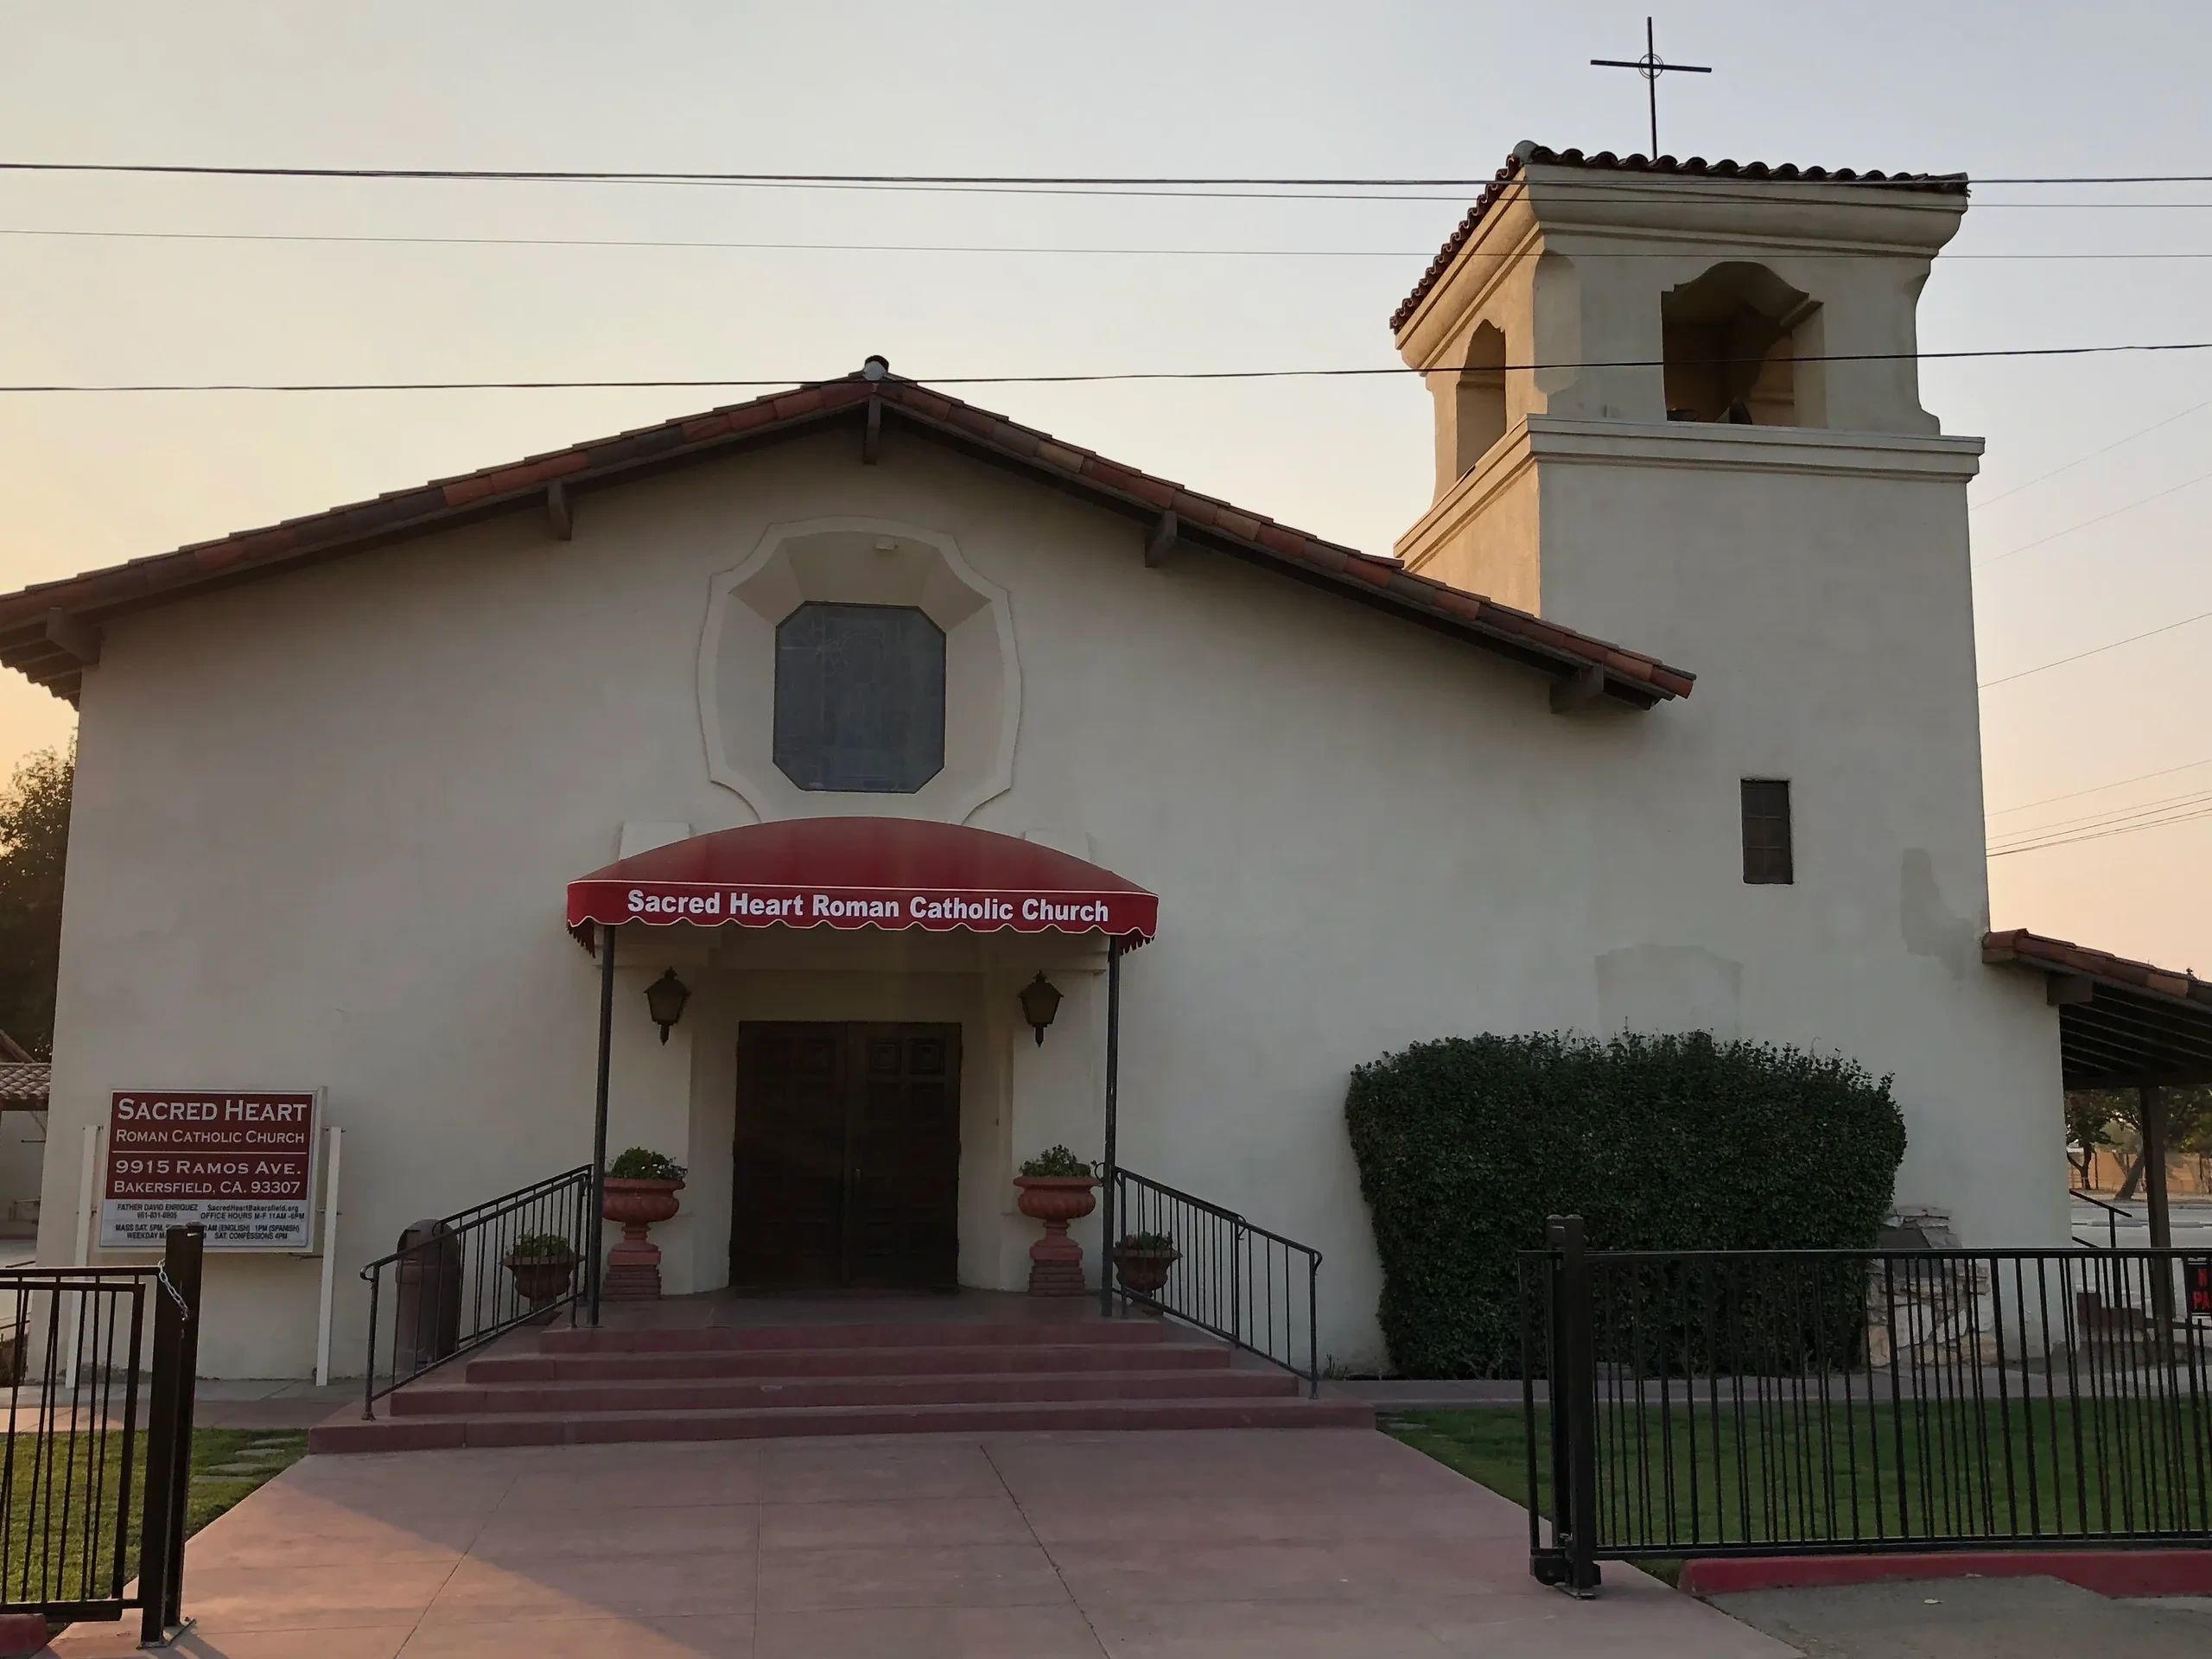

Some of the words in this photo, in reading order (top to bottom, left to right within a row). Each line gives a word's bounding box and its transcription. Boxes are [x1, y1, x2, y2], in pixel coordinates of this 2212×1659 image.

[627, 889, 721, 914] Sacred
[729, 893, 804, 916] Heart
[812, 894, 899, 918] Roman
[910, 896, 1014, 920] Catholic
[1022, 899, 1109, 922] Church
[118, 1098, 218, 1121] SACRED
[225, 1099, 308, 1122] HEART
[116, 1129, 168, 1143] ROMAN
[172, 1129, 243, 1143] CATHOLIC
[245, 1130, 305, 1144] CHURCH
[116, 1160, 170, 1174] 9915
[175, 1160, 250, 1174] RAMOS
[255, 1161, 302, 1175] AVE.
[114, 1180, 216, 1194] BAKERSFIELD,
[220, 1181, 247, 1194] CA.
[251, 1181, 301, 1194] 93307
